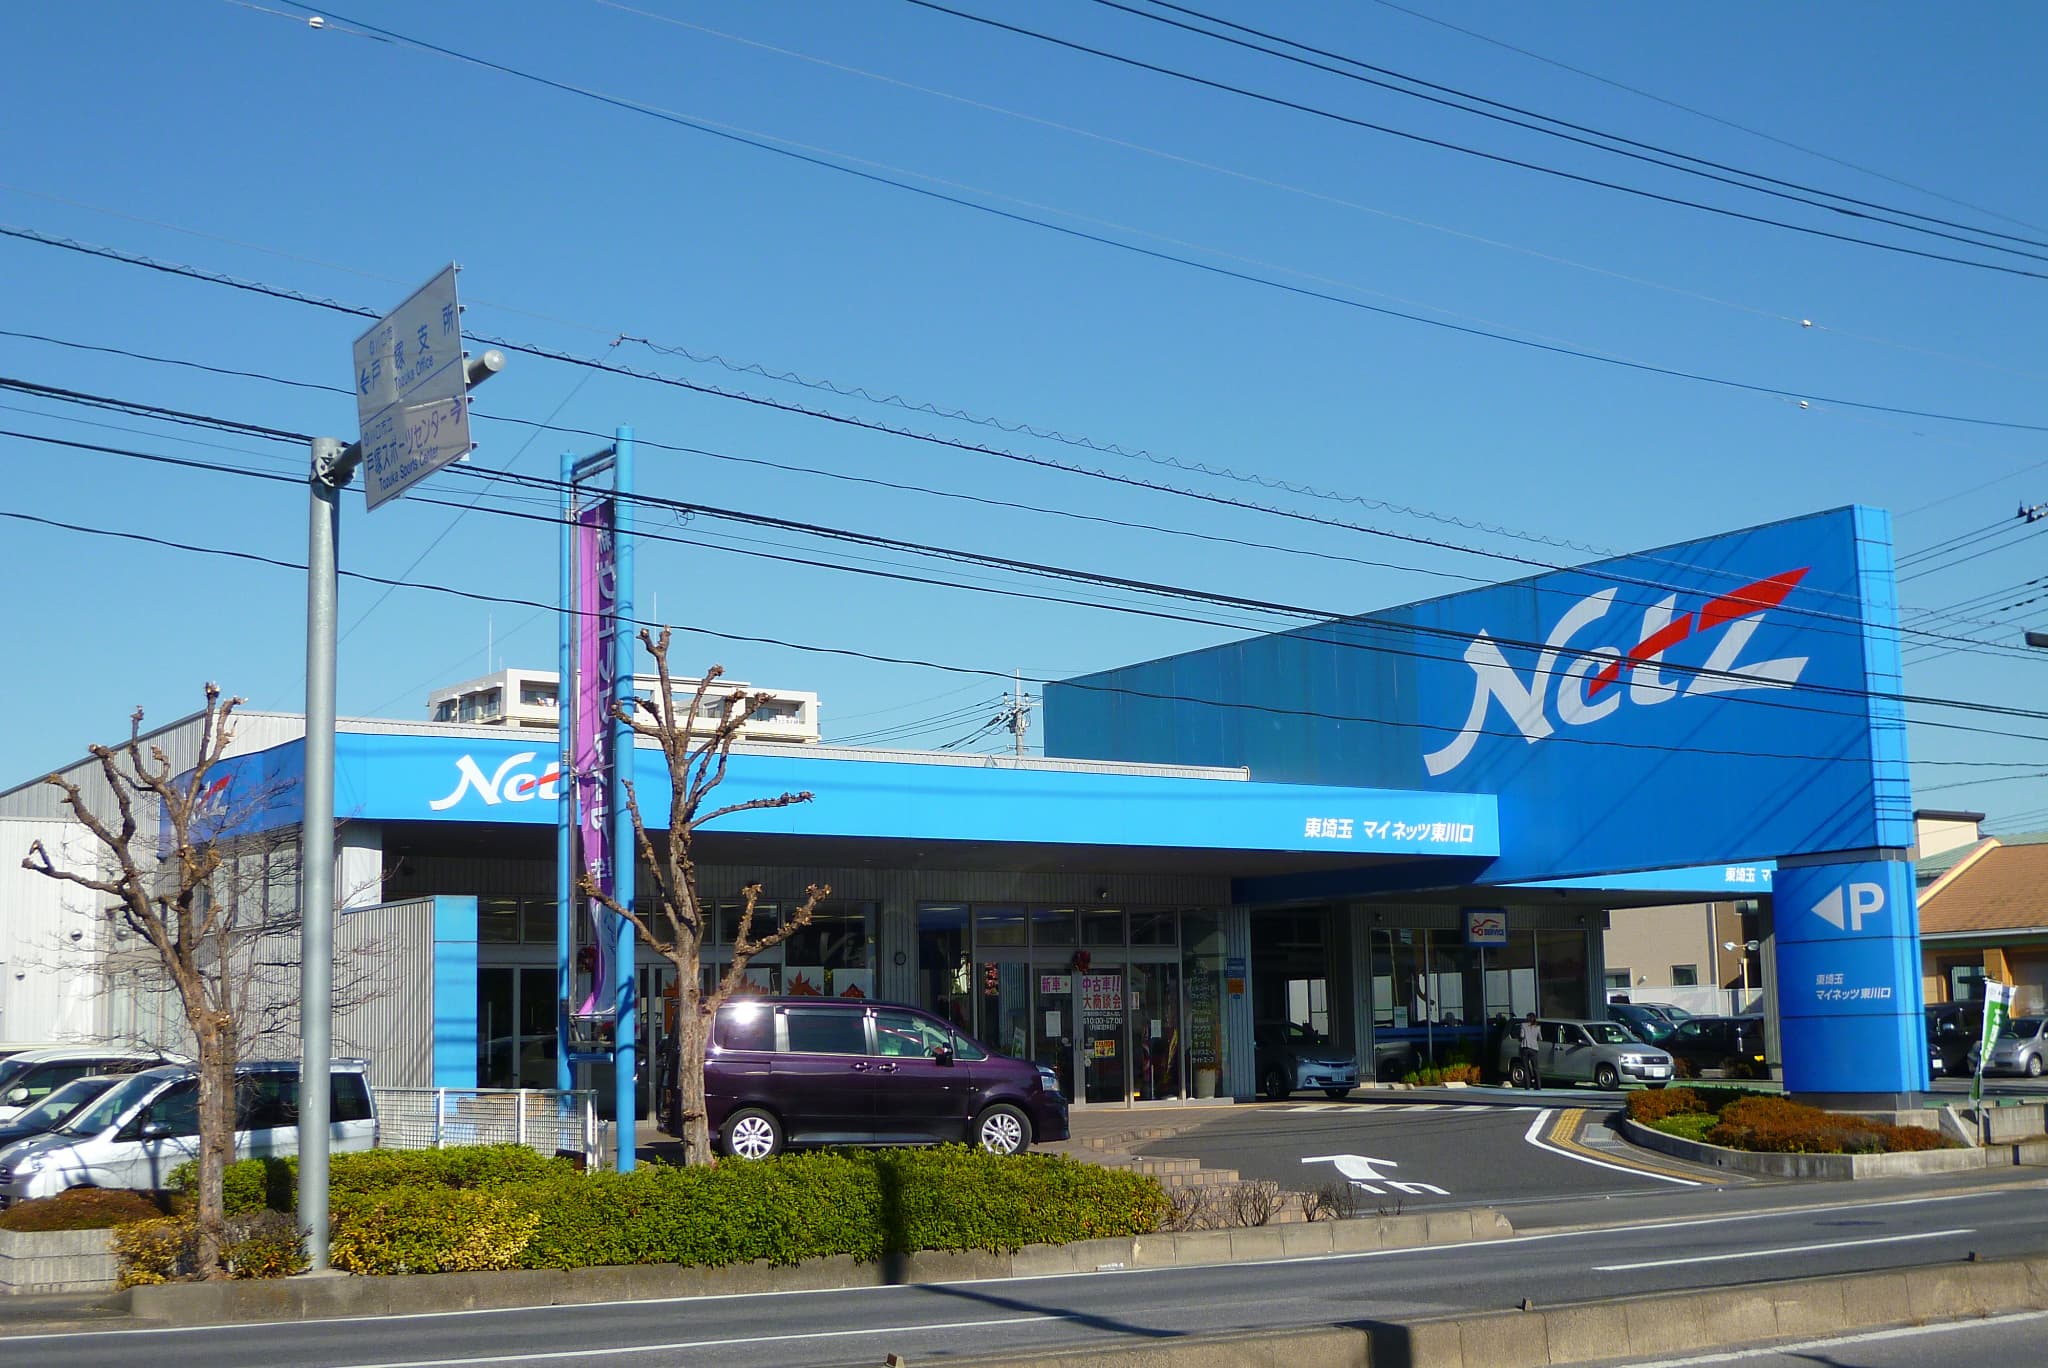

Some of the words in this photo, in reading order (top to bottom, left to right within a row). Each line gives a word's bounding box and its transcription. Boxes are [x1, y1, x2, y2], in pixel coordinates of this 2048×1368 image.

[366, 410, 447, 476] 戸塚スポーツセンター
[400, 458, 418, 481] Sports
[419, 445, 439, 467] Center
[1423, 566, 1812, 776] Netz
[429, 751, 560, 811] Net
[1304, 817, 1354, 839] 東埼玉
[1363, 820, 1474, 843] マイネッツ東川口
[1725, 867, 1756, 882] 東埼玉
[1850, 883, 1885, 931] P
[1816, 973, 1844, 985] 東埼玉
[1082, 993, 1121, 1009] 大商談会
[1349, 1180, 1451, 1195] in
